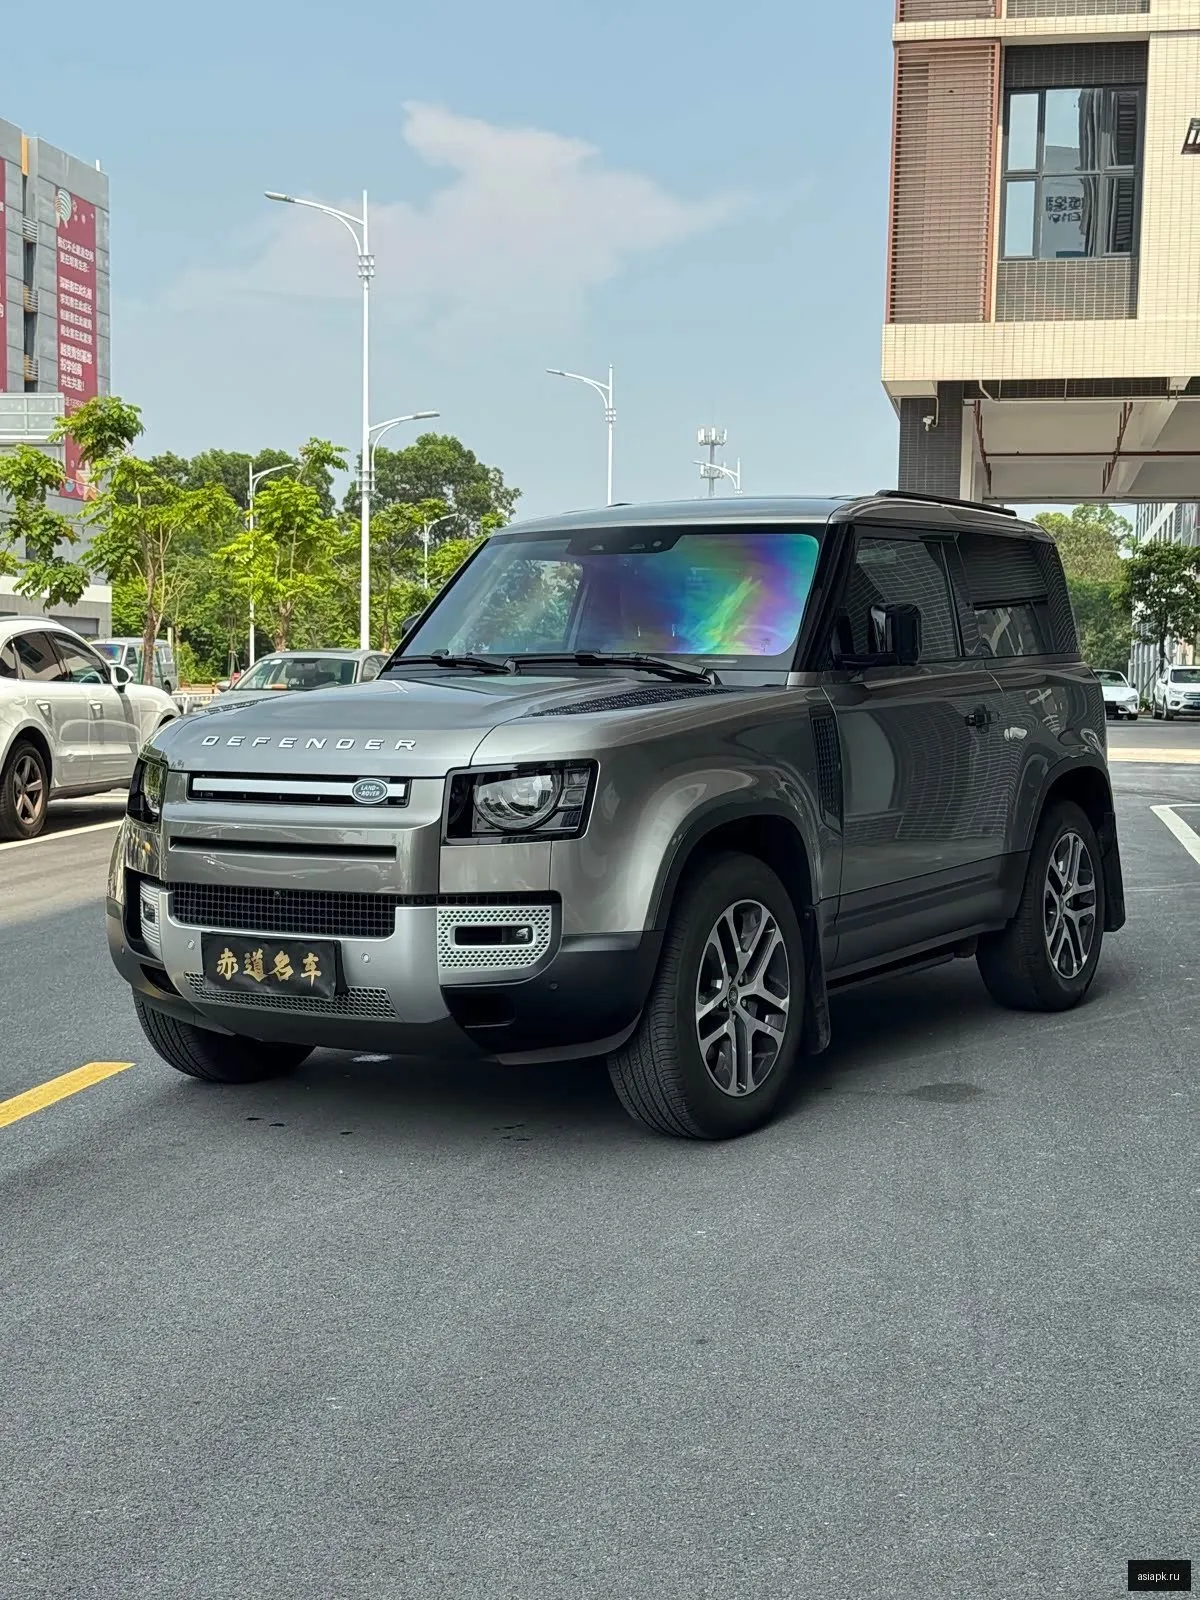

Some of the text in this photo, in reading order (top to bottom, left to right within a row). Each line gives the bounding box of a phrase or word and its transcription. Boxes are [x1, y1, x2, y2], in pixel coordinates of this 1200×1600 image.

[201, 735, 417, 751] DEFENDER
[216, 947, 322, 987] 赤道名车
